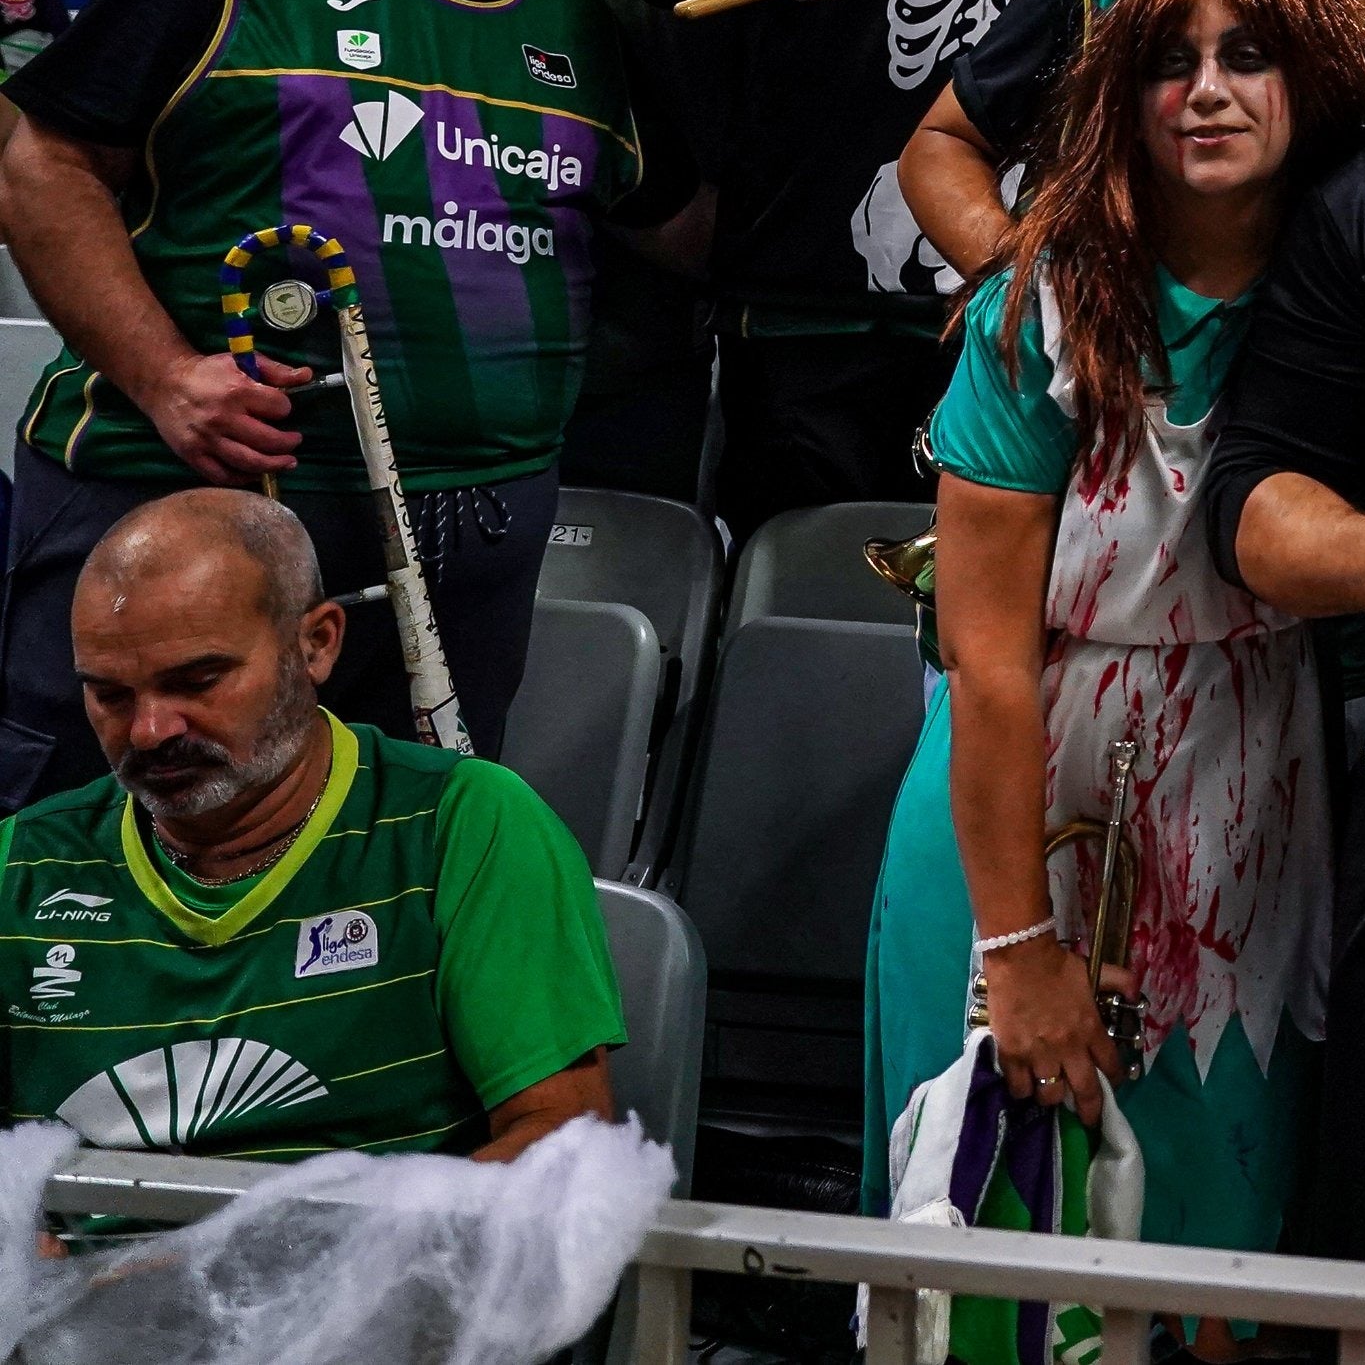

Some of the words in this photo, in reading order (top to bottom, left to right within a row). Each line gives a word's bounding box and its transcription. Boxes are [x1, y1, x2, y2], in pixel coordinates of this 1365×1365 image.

[529, 54, 547, 70] liga
[532, 64, 572, 84] endesa
[436, 121, 582, 191] Unicaja
[382, 200, 554, 265] málaga
[553, 526, 579, 543] 21
[34, 910, 112, 922] LI-NING
[322, 934, 349, 954] liga
[321, 948, 373, 966] endesa
